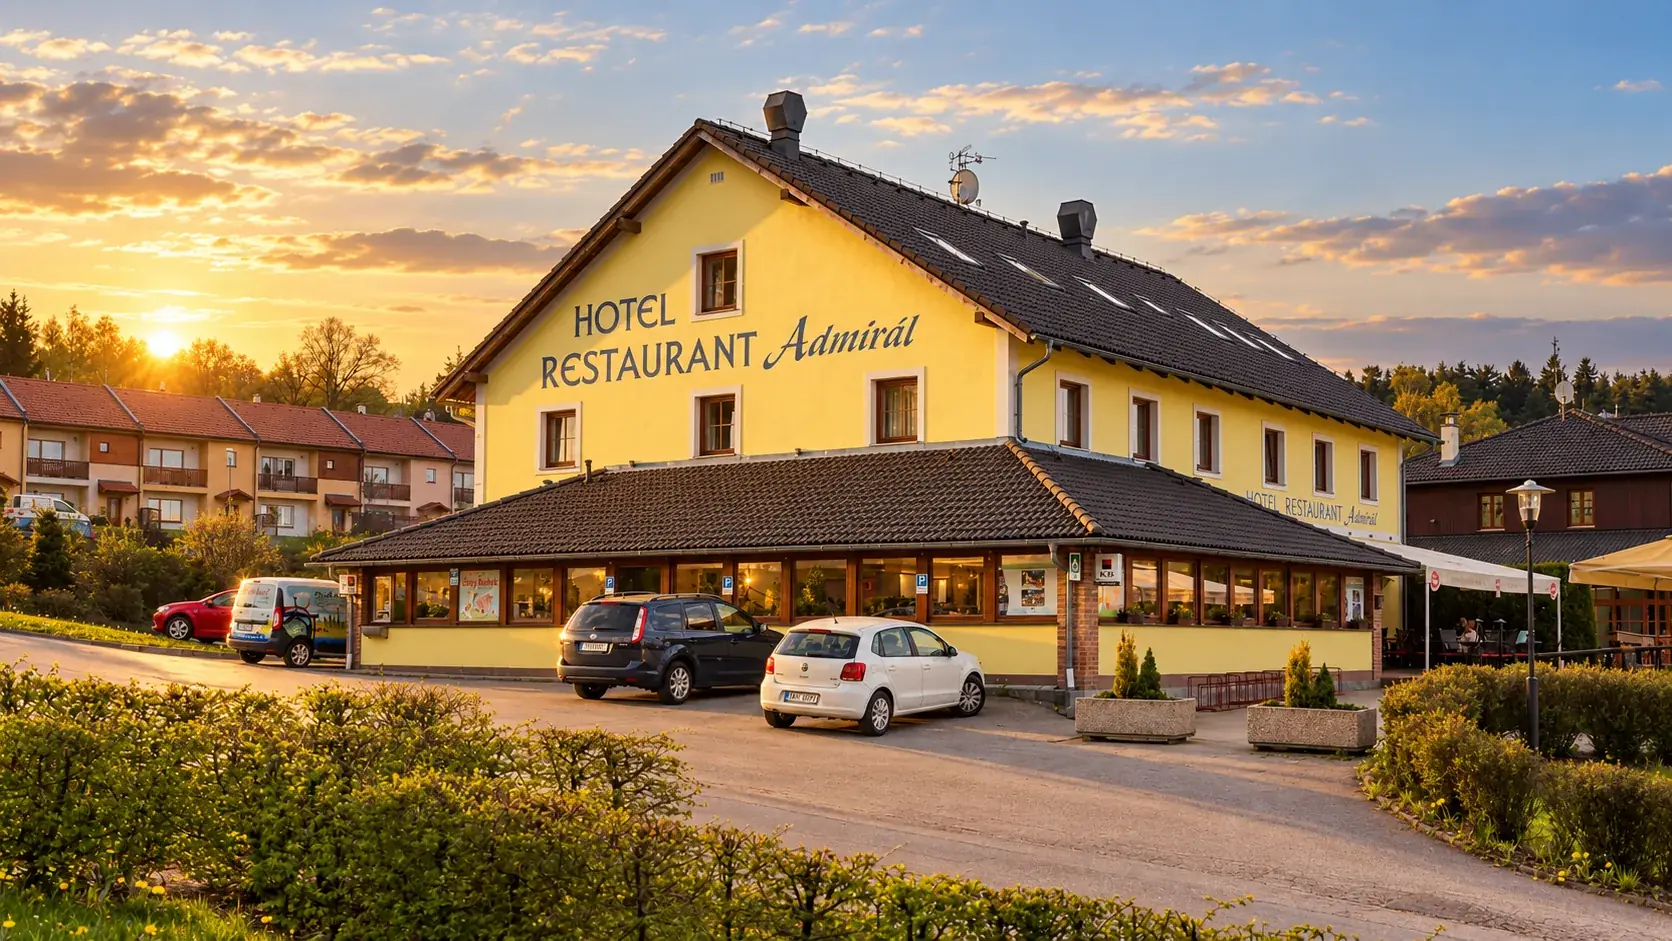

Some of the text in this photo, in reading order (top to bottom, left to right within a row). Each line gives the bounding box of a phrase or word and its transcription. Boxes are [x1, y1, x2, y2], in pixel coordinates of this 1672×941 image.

[574, 293, 675, 338] HOTEL
[541, 314, 920, 389] RESTAURANT Admirál
[1246, 490, 1279, 512] HOTEL
[1285, 497, 1343, 522] RESTAURANT
